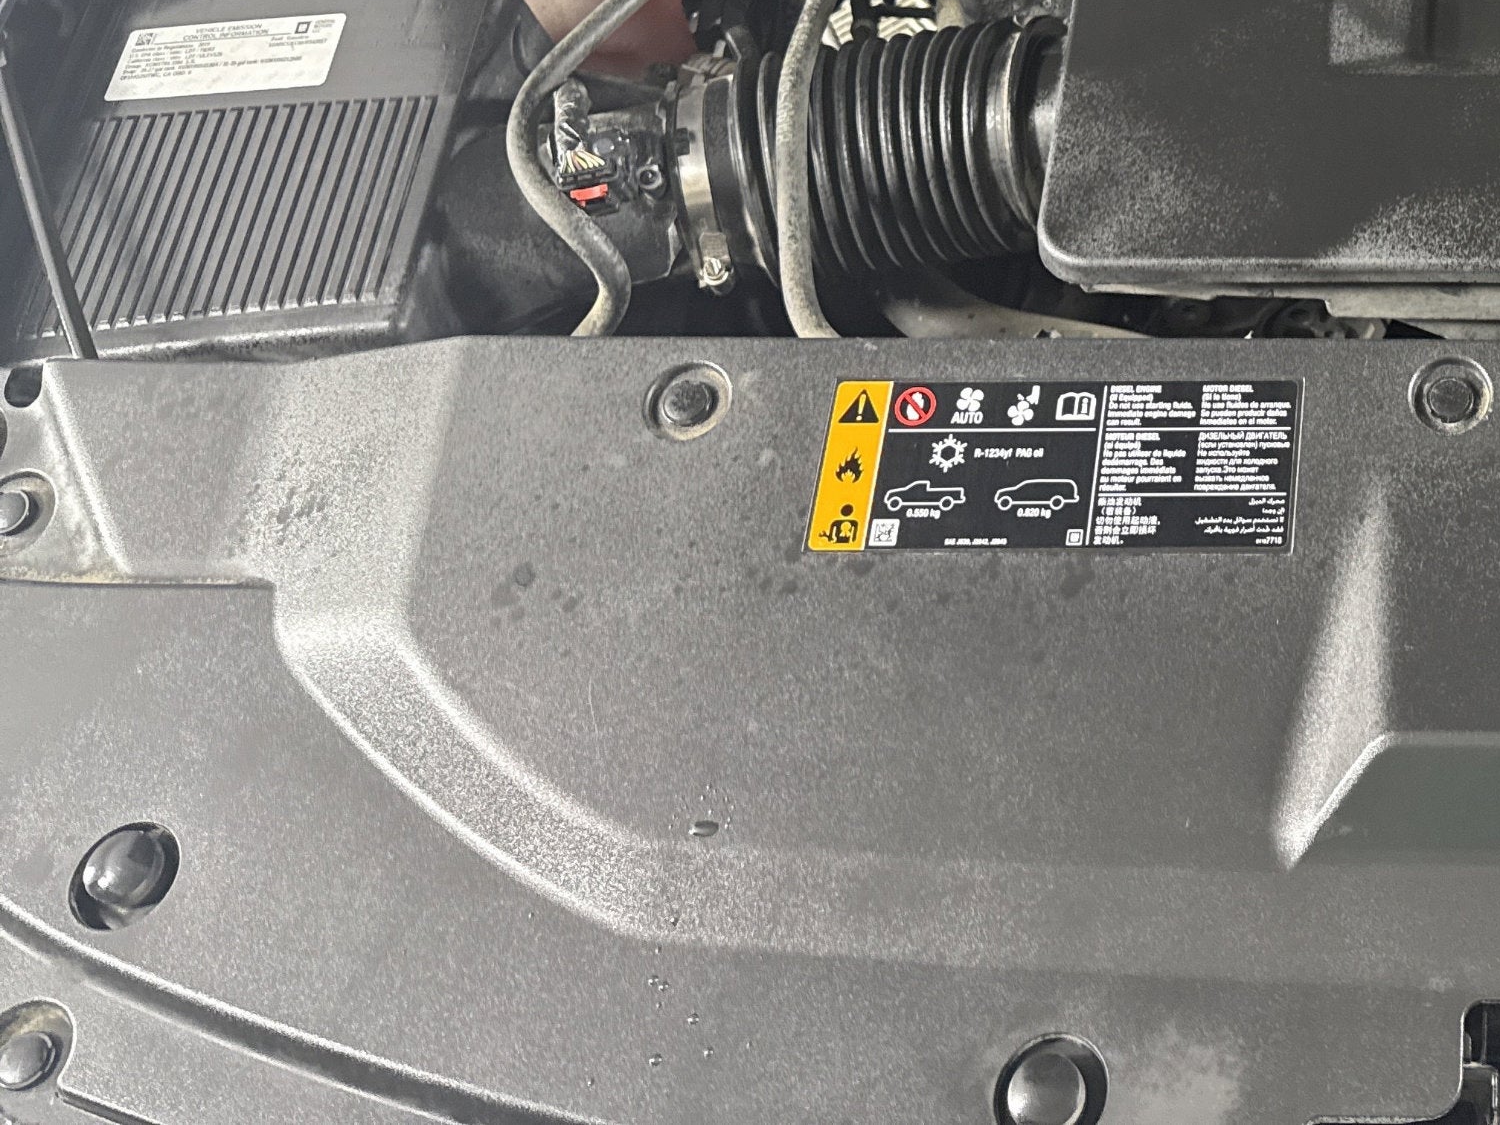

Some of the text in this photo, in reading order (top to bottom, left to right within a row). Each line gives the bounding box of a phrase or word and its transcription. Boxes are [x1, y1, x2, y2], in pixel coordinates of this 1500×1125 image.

[1202, 384, 1254, 393] MOTOR DIESEL
[1145, 401, 1171, 410] starting
[951, 411, 983, 425] AUTO
[1144, 410, 1167, 419] engine
[1168, 410, 1196, 419] damage
[1245, 431, 1288, 441] ДВИГАТЕЛЬ
[974, 447, 1012, 460] R-1234yf
[1015, 447, 1032, 458] PAG
[1152, 449, 1162, 457] de
[930, 507, 941, 519] kg
[1040, 507, 1051, 519] kg
